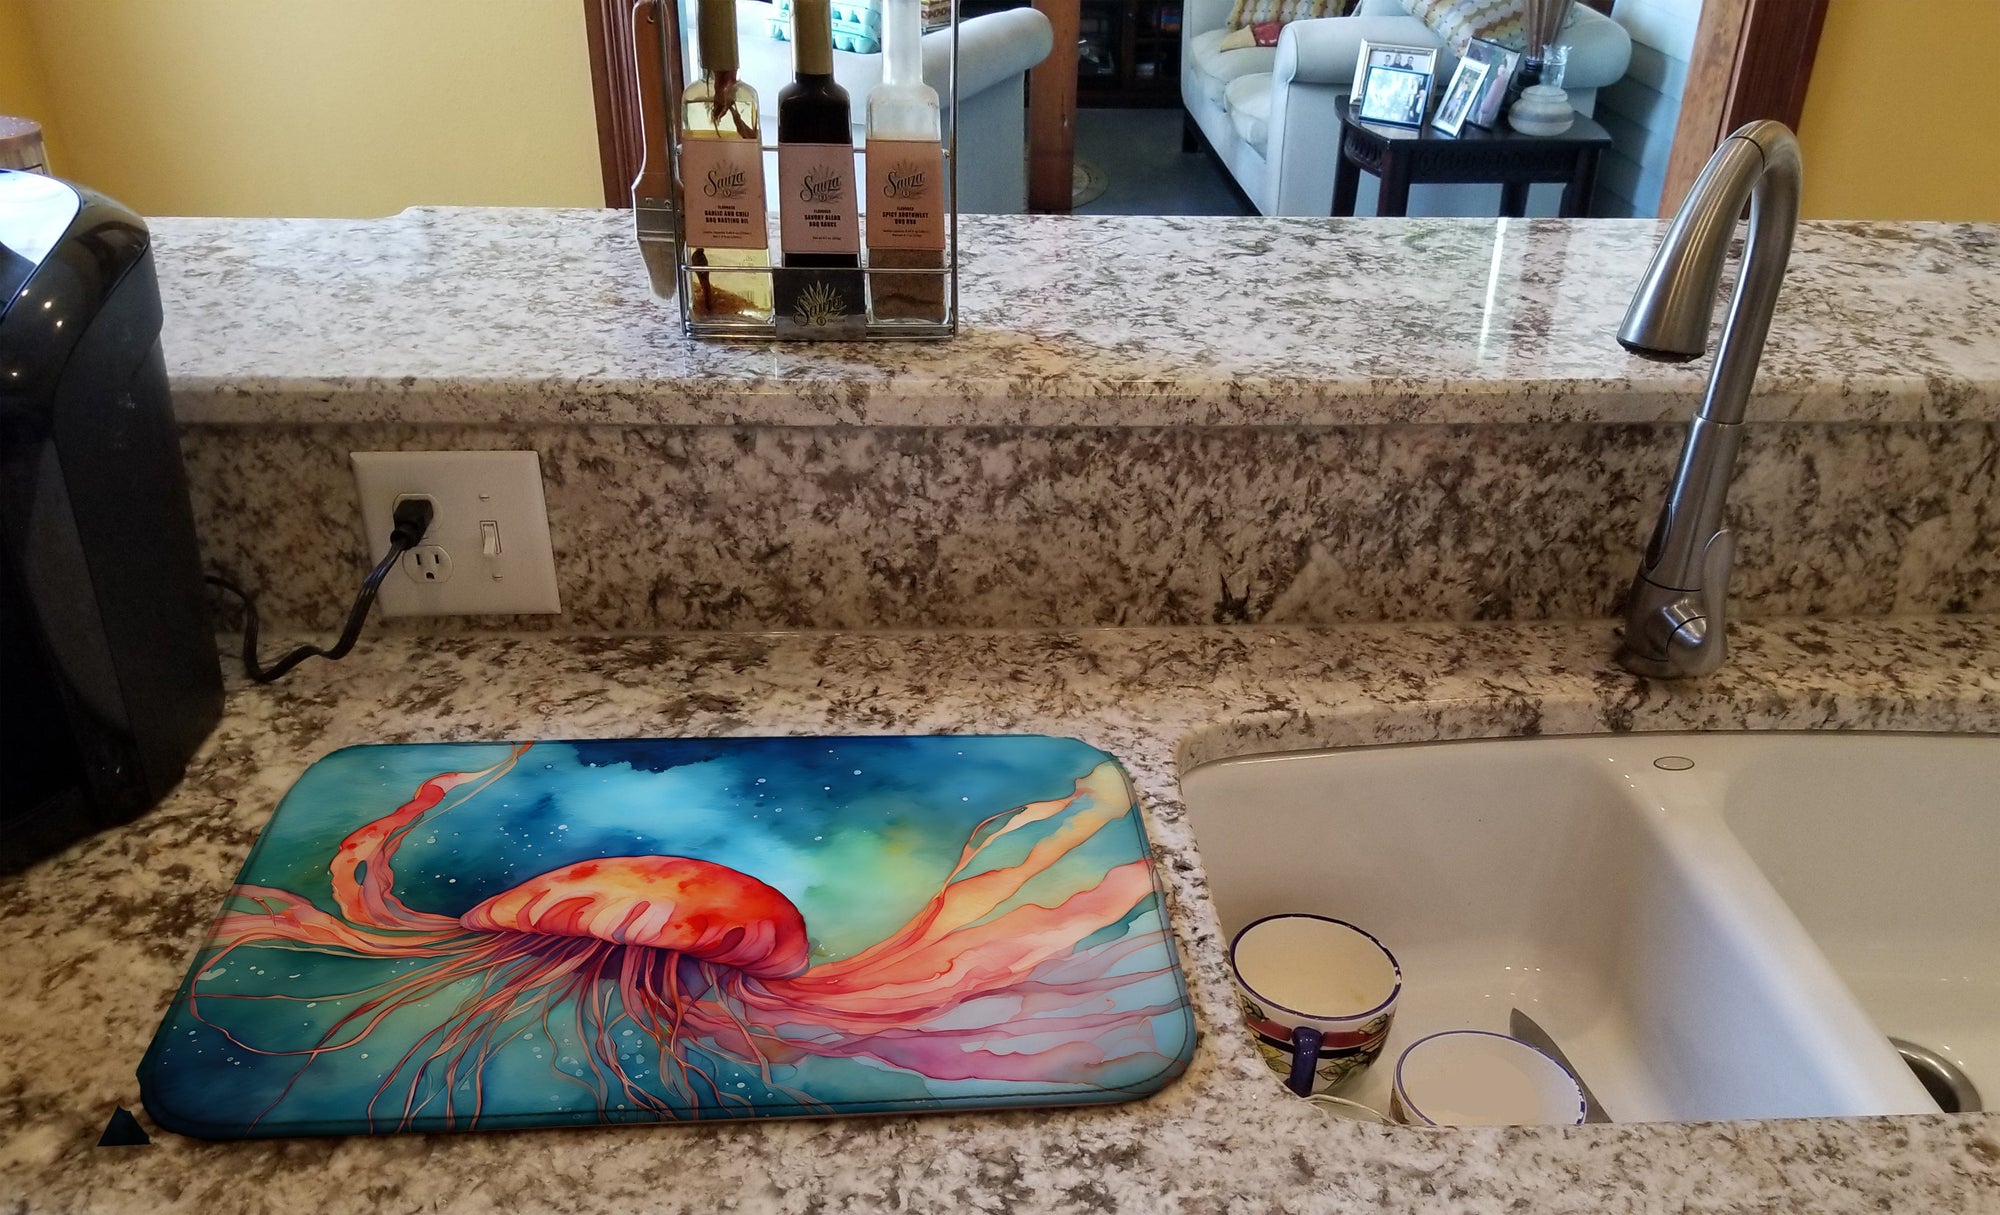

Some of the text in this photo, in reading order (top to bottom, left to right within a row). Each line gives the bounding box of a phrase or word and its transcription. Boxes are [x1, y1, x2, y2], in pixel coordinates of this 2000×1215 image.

[703, 170, 745, 197] Sauza
[800, 175, 841, 201] Sauza
[883, 171, 925, 198] Sauza
[793, 295, 843, 326] Sauza
